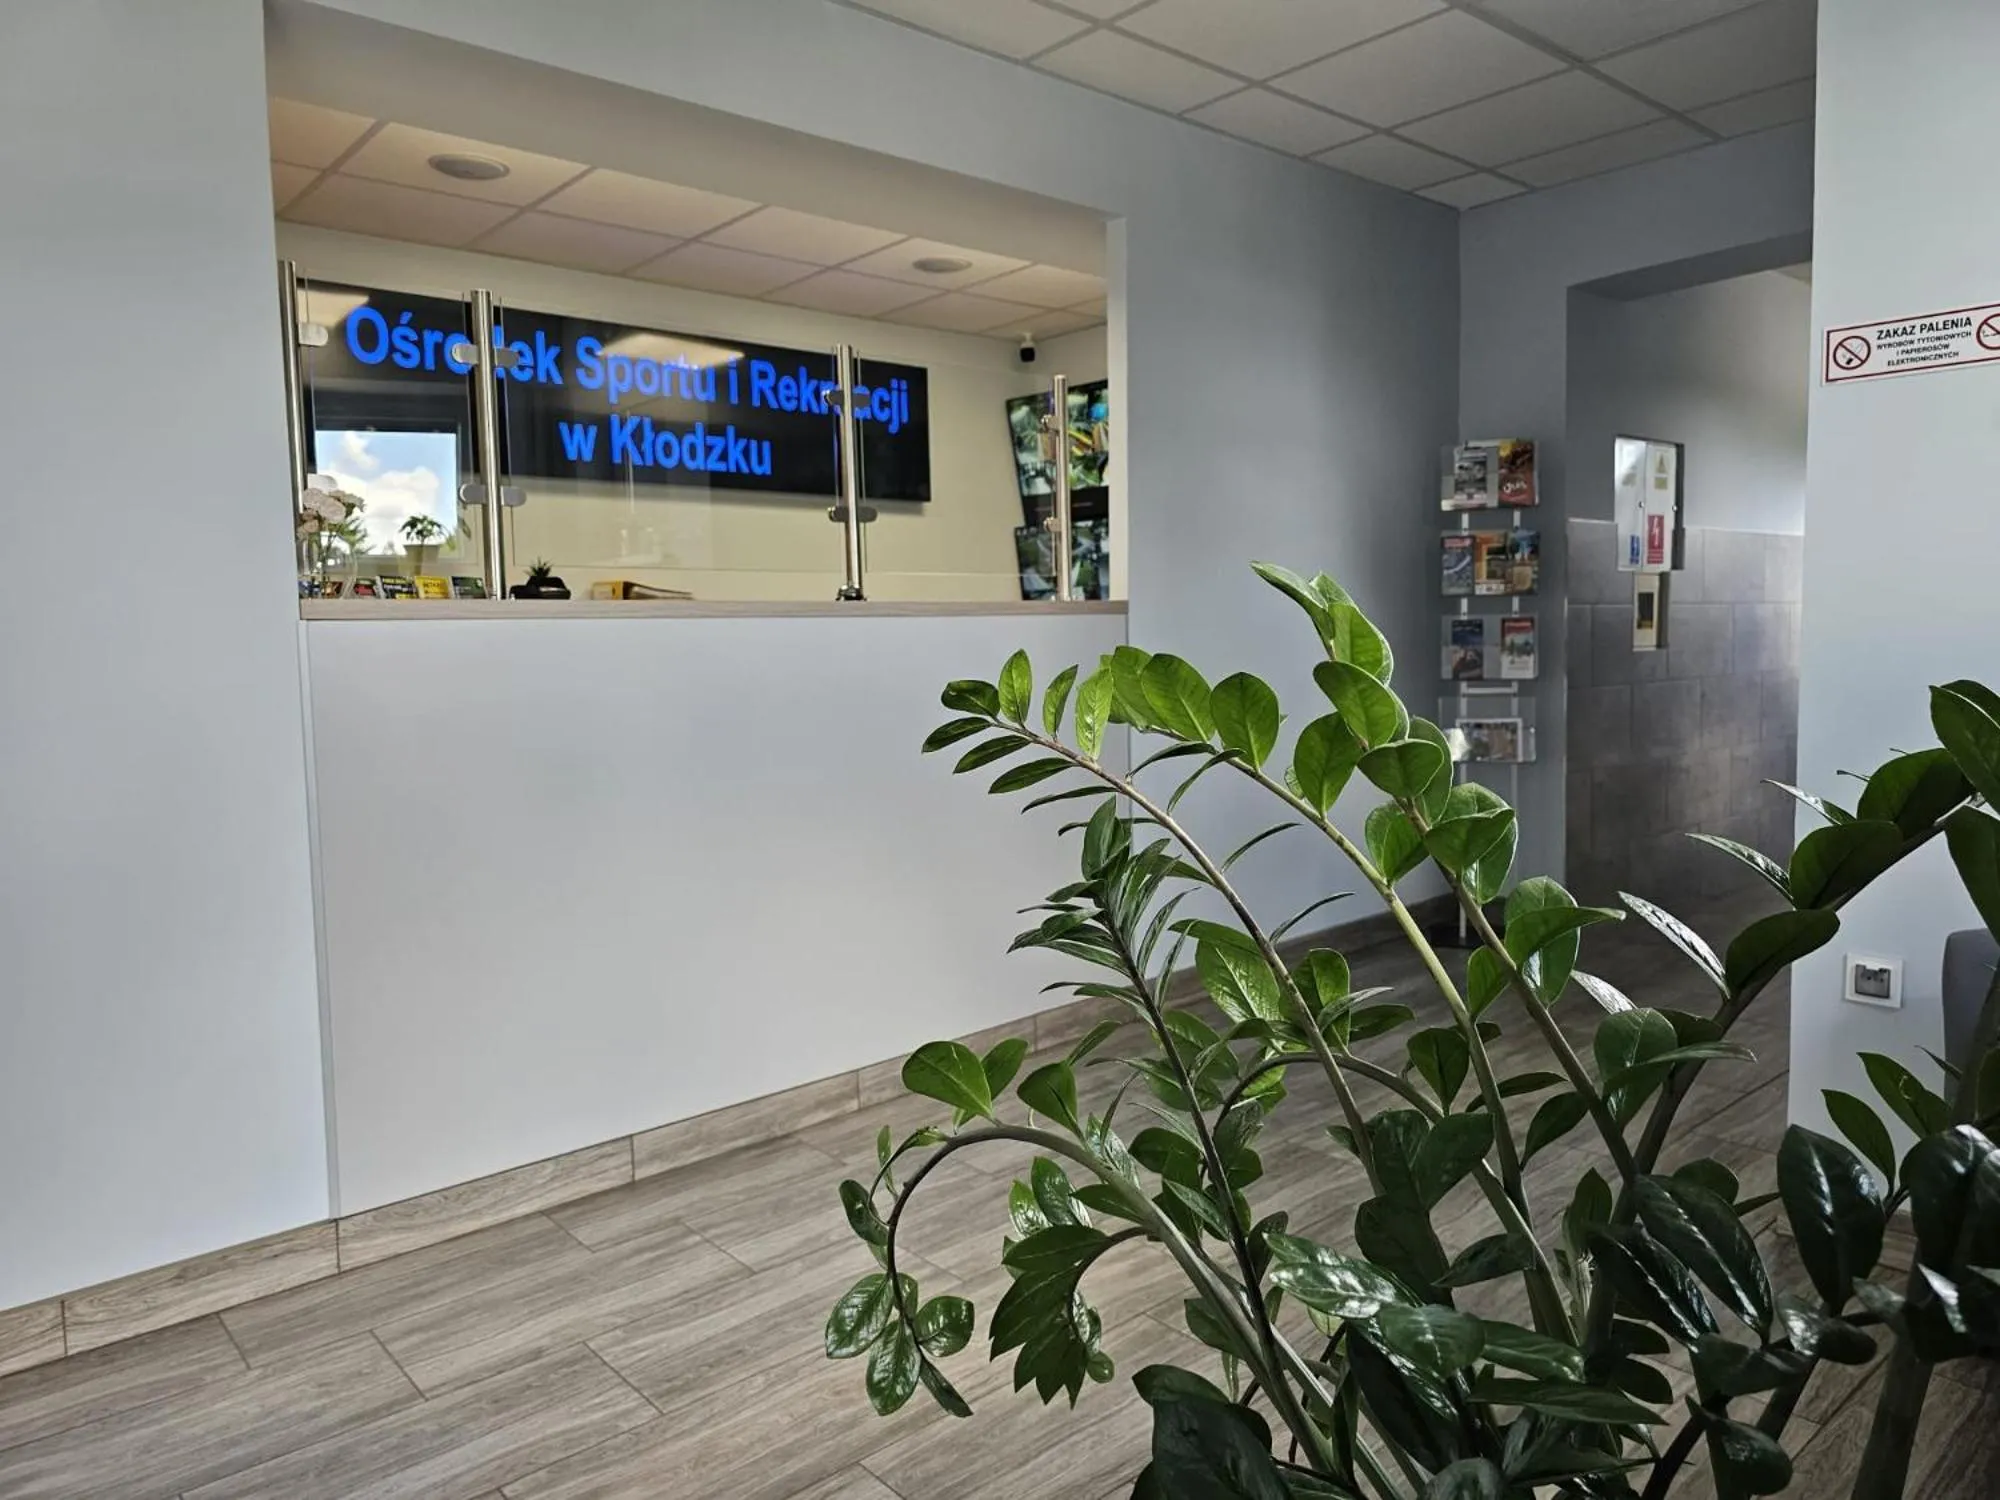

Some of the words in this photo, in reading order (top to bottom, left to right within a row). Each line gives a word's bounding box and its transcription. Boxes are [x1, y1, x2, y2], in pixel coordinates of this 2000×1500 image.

[1877, 325, 1916, 340] ZAKAZ
[1920, 317, 1972, 333] PALENIA
[1917, 331, 1972, 344] TYTONIOWYCH
[1901, 343, 1950, 355] PAPIEROSÓW
[1887, 352, 1959, 366] ELEKTRONICZNYCH
[575, 335, 717, 404] Sportu
[728, 353, 739, 405] i
[750, 359, 909, 434] Rekracji
[559, 422, 598, 463] w
[609, 414, 772, 476] Kłodzku
